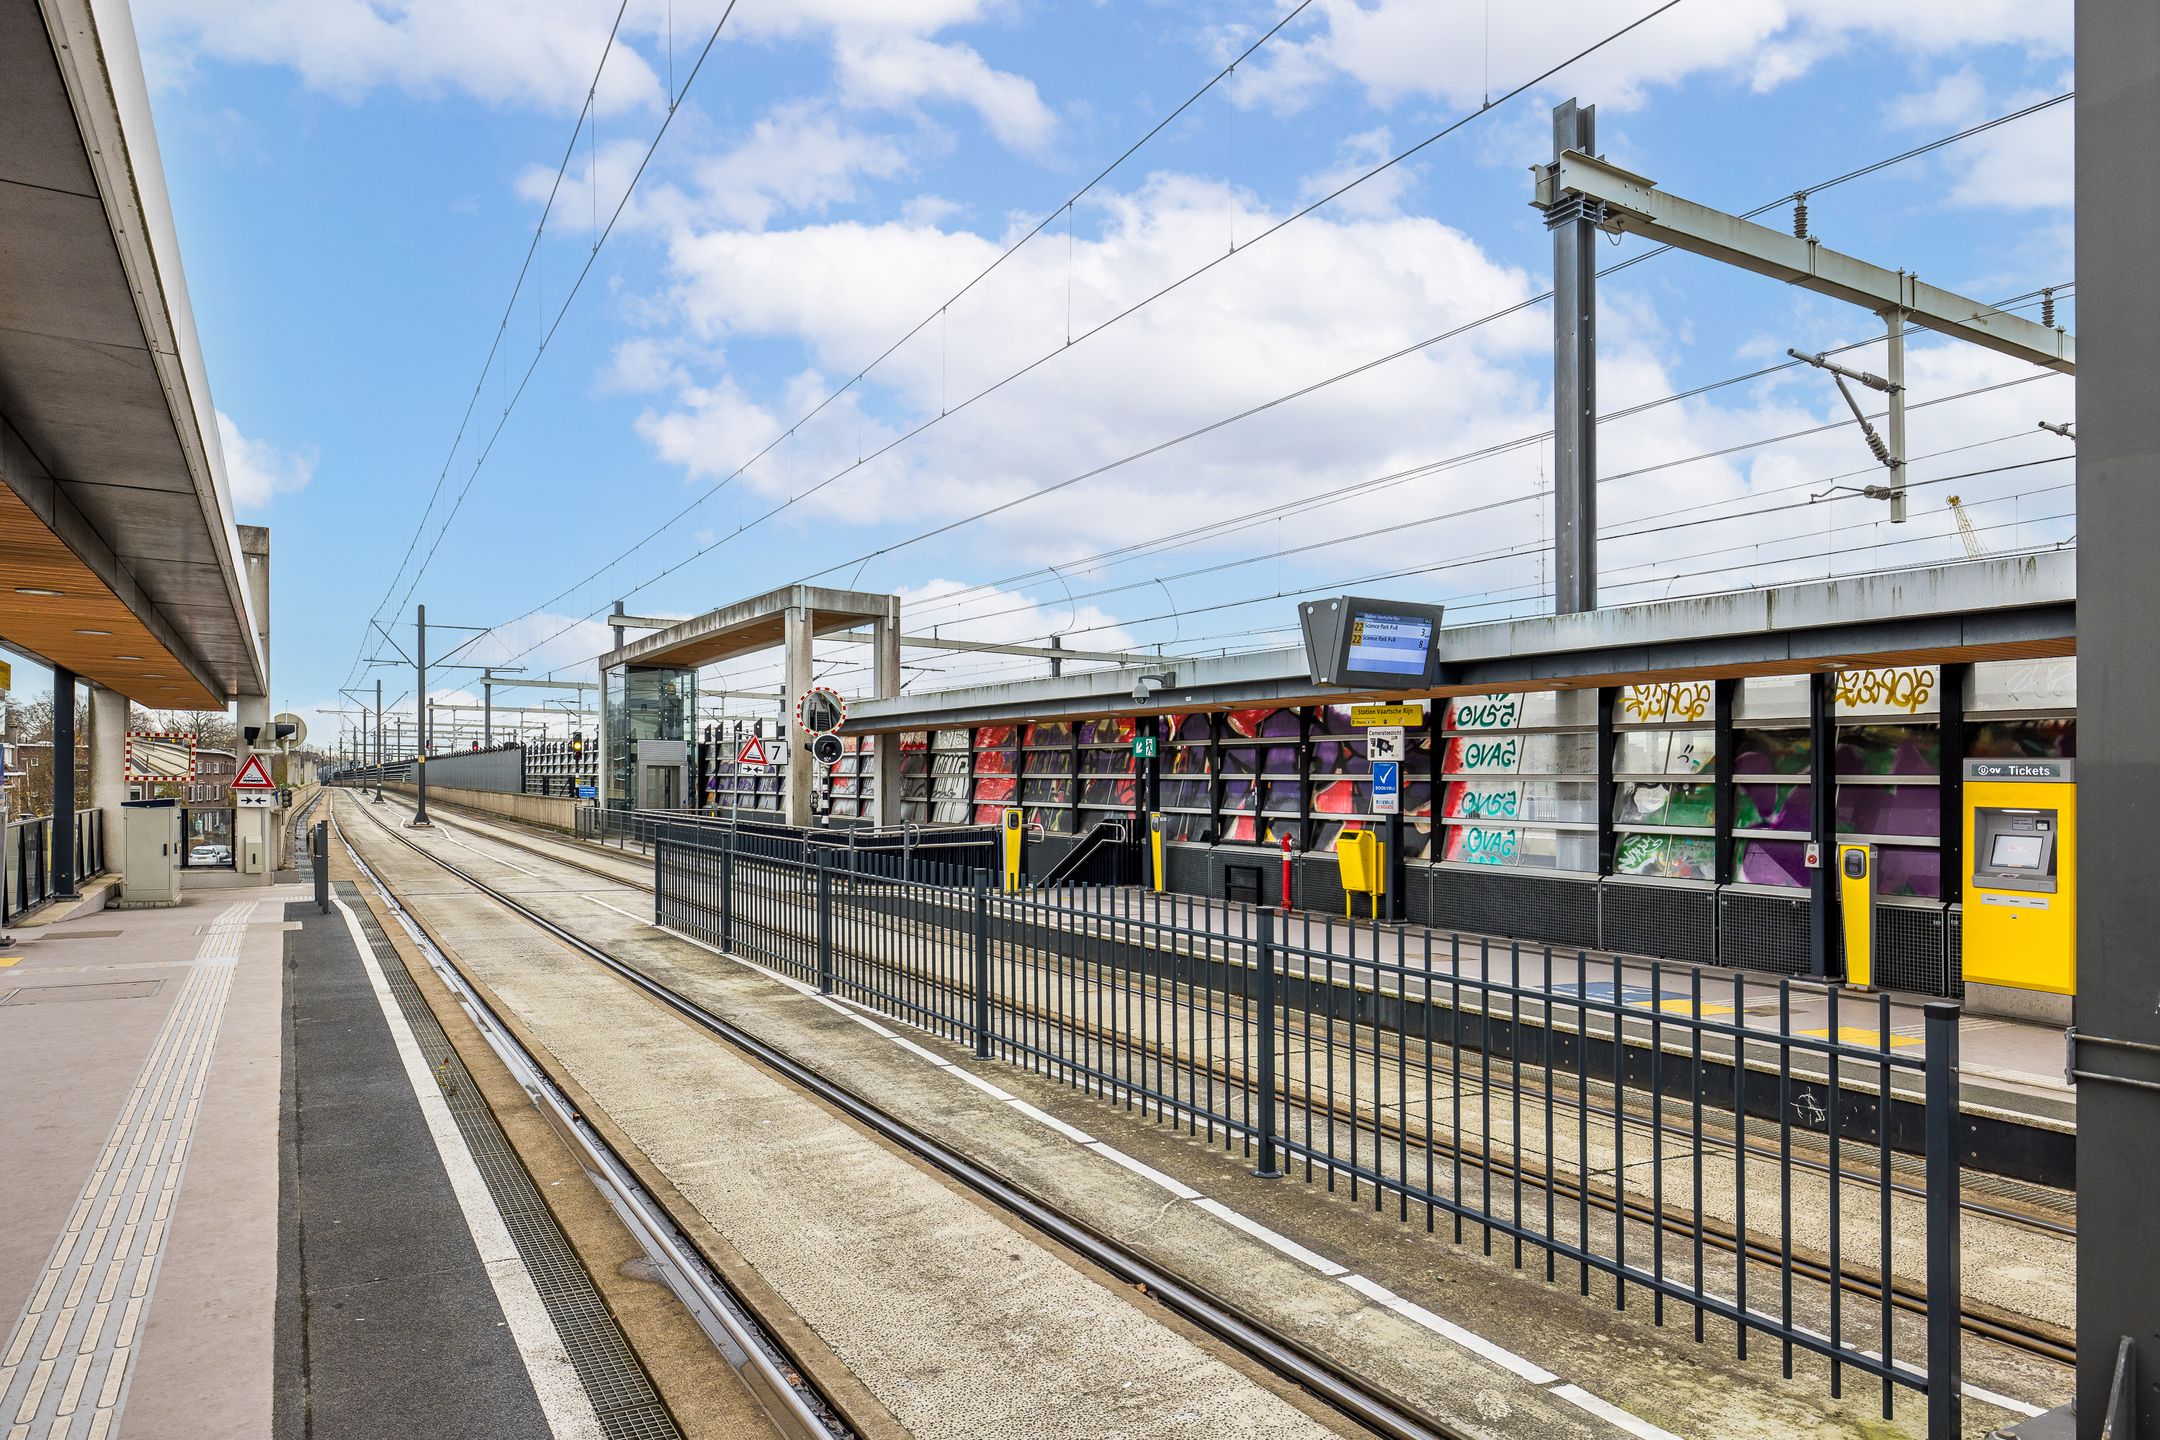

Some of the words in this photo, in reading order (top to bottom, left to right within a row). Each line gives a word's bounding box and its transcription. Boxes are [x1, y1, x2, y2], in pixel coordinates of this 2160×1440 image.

[1354, 622, 1364, 632] 22
[1420, 628, 1426, 637] 3
[1352, 634, 1362, 644] 22
[1418, 640, 1424, 649] 8
[1402, 707, 1414, 716] Rijn
[771, 746, 781, 761] 7
[2008, 765, 2050, 776] Tickets
